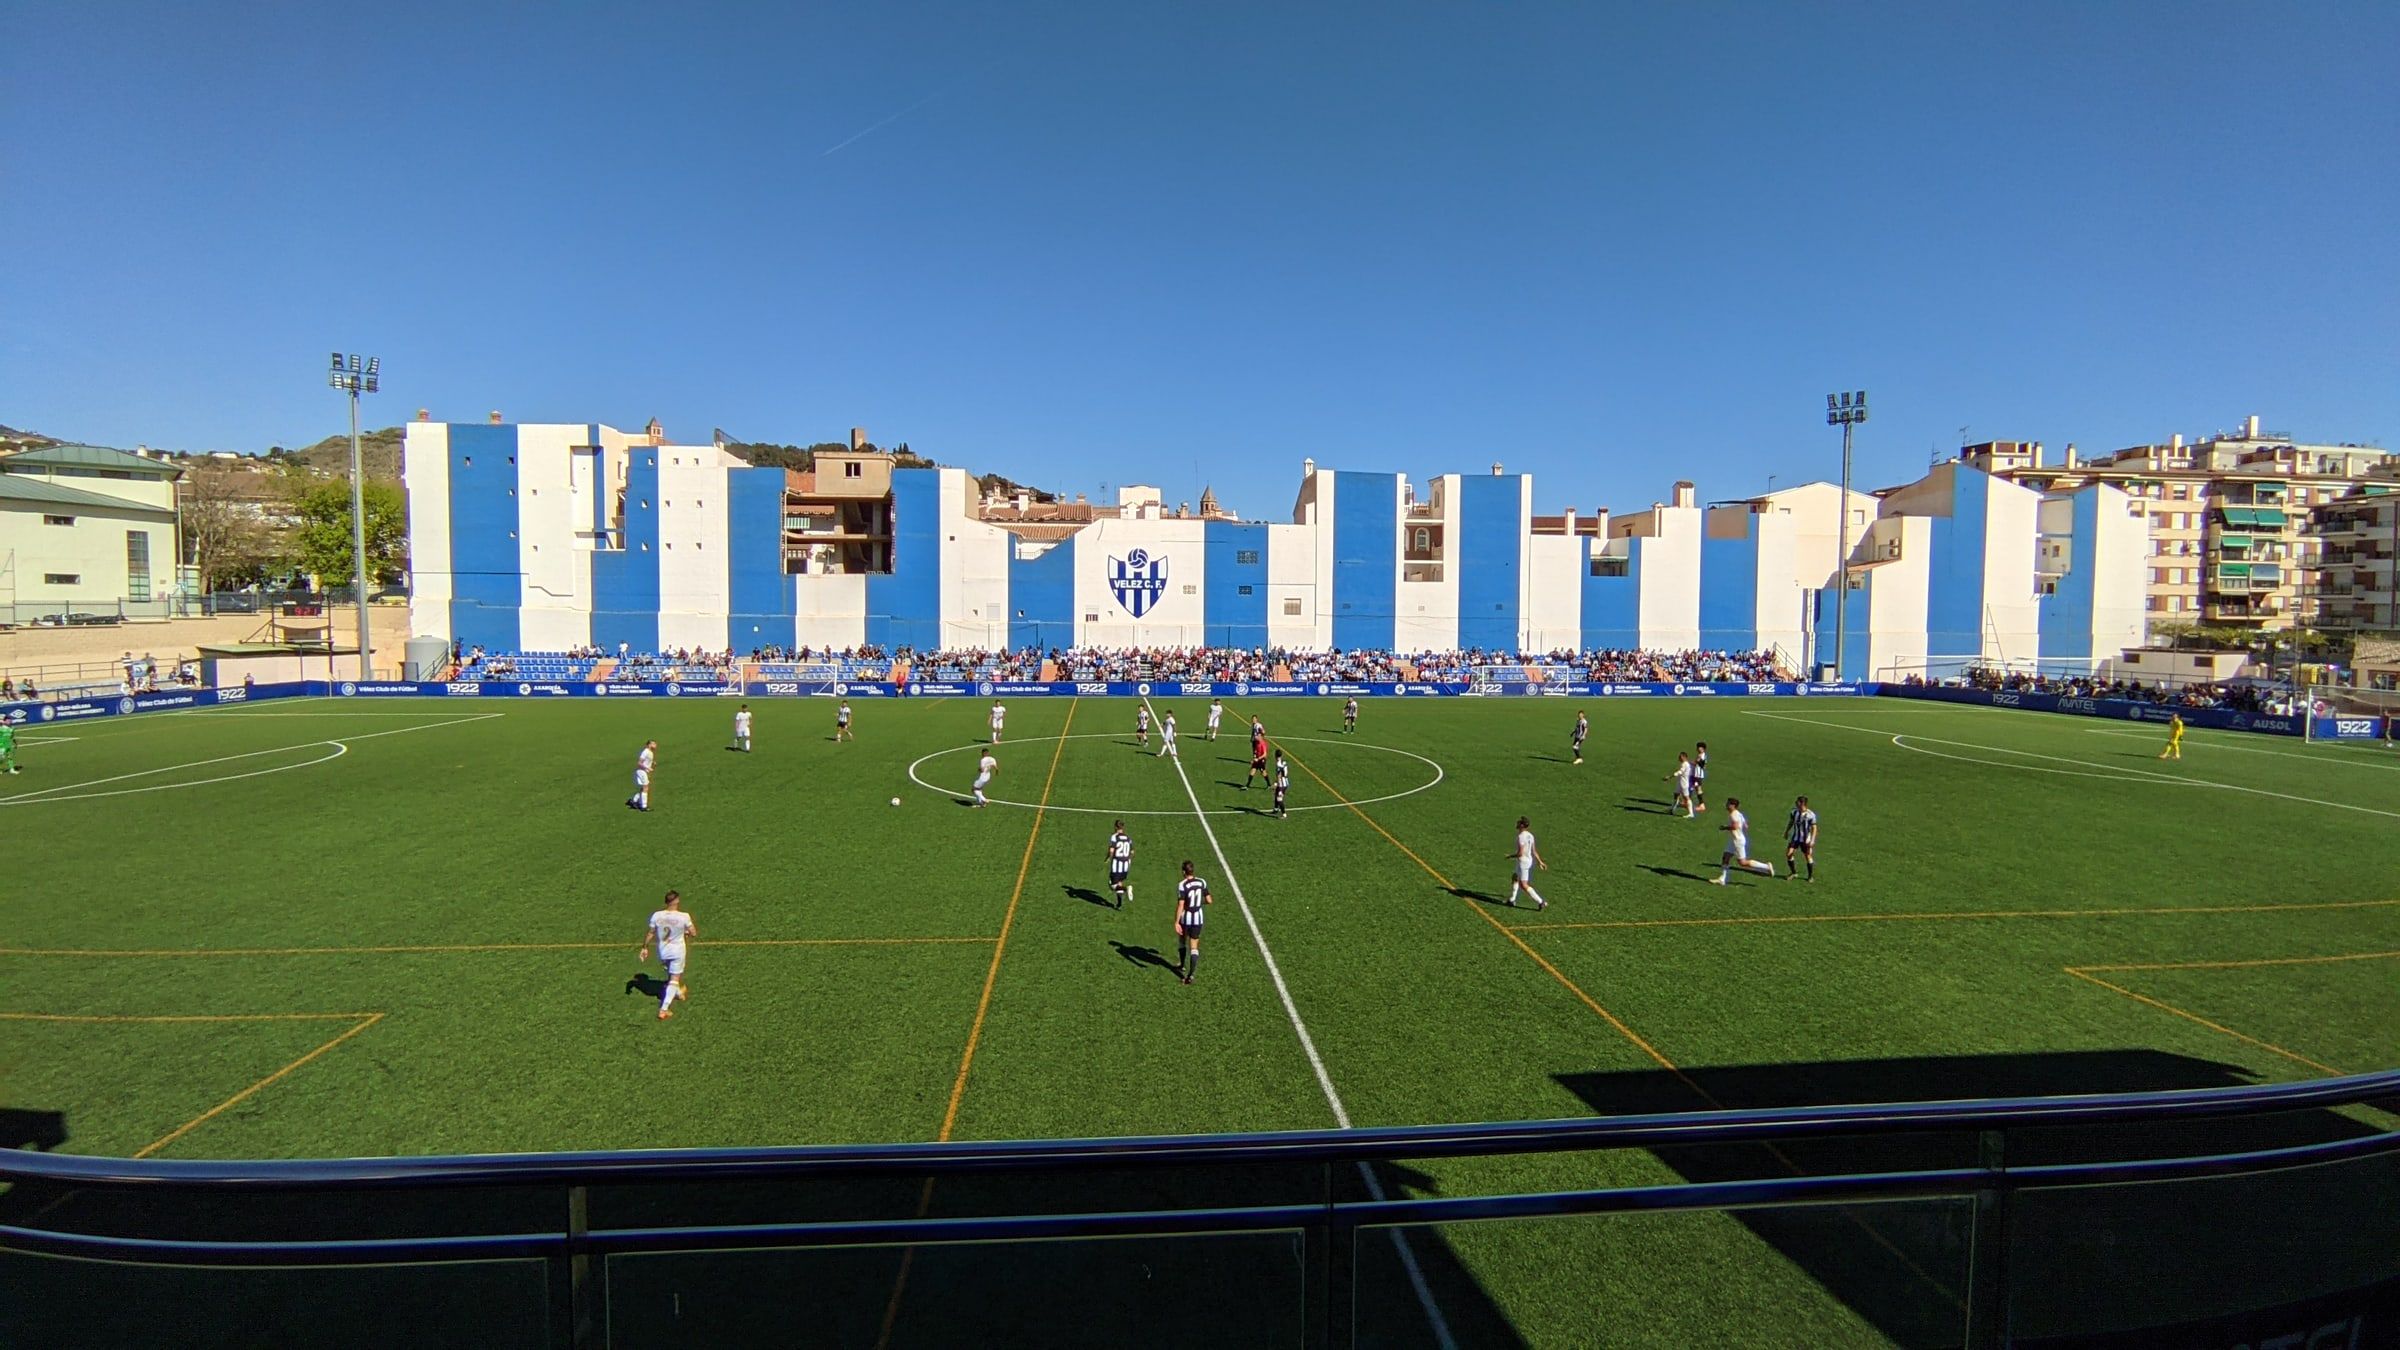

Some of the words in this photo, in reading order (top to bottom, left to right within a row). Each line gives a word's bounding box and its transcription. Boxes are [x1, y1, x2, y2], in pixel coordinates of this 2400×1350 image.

[1114, 580, 1143, 589] VELEZ
[1144, 580, 1153, 589] C.
[1155, 580, 1163, 589] F.
[445, 684, 479, 693] 1922
[765, 684, 798, 693] 1922
[1076, 684, 1107, 693] 1922
[1180, 684, 1211, 693] 1922
[1748, 684, 1775, 693] 1922
[216, 688, 246, 700] 1922
[1992, 694, 2019, 704] 1922
[2058, 698, 2096, 710] AVATEL
[2252, 720, 2291, 730] AUSOL
[2336, 721, 2371, 734] 1922
[1115, 841, 1130, 857] 20
[1188, 888, 1202, 907] 11
